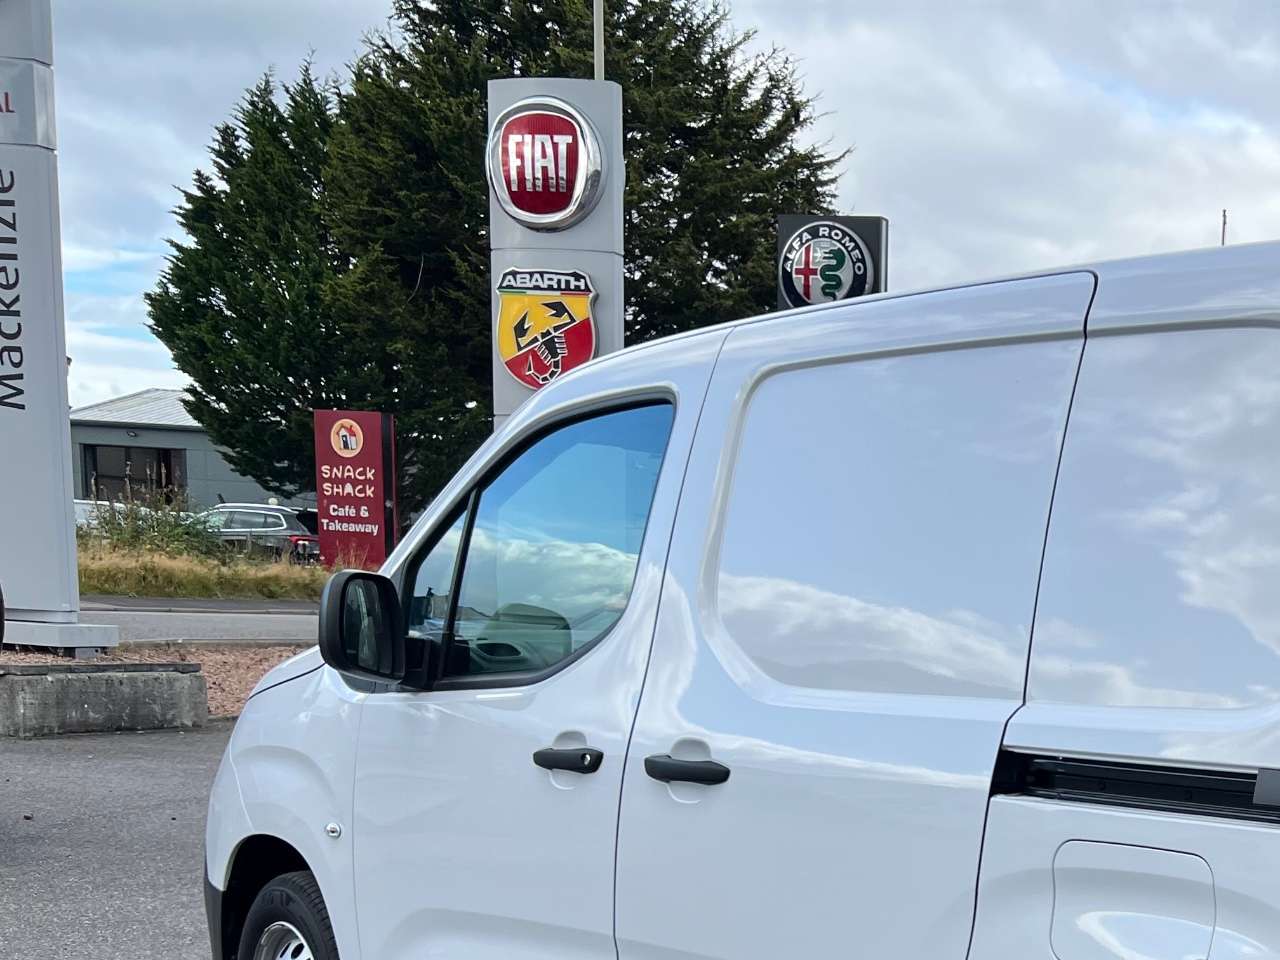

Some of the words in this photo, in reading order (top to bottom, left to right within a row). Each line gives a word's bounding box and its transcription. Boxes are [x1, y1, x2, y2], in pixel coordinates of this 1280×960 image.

[507, 133, 573, 193] FIAT
[783, 231, 812, 273] ALFA
[818, 226, 865, 275] ROMEO
[501, 272, 586, 291] ABARTH
[320, 464, 376, 481] SNACK
[322, 482, 375, 498] SHACK
[329, 503, 357, 517] Café
[359, 505, 370, 518] &
[320, 518, 379, 537] Takeaway
